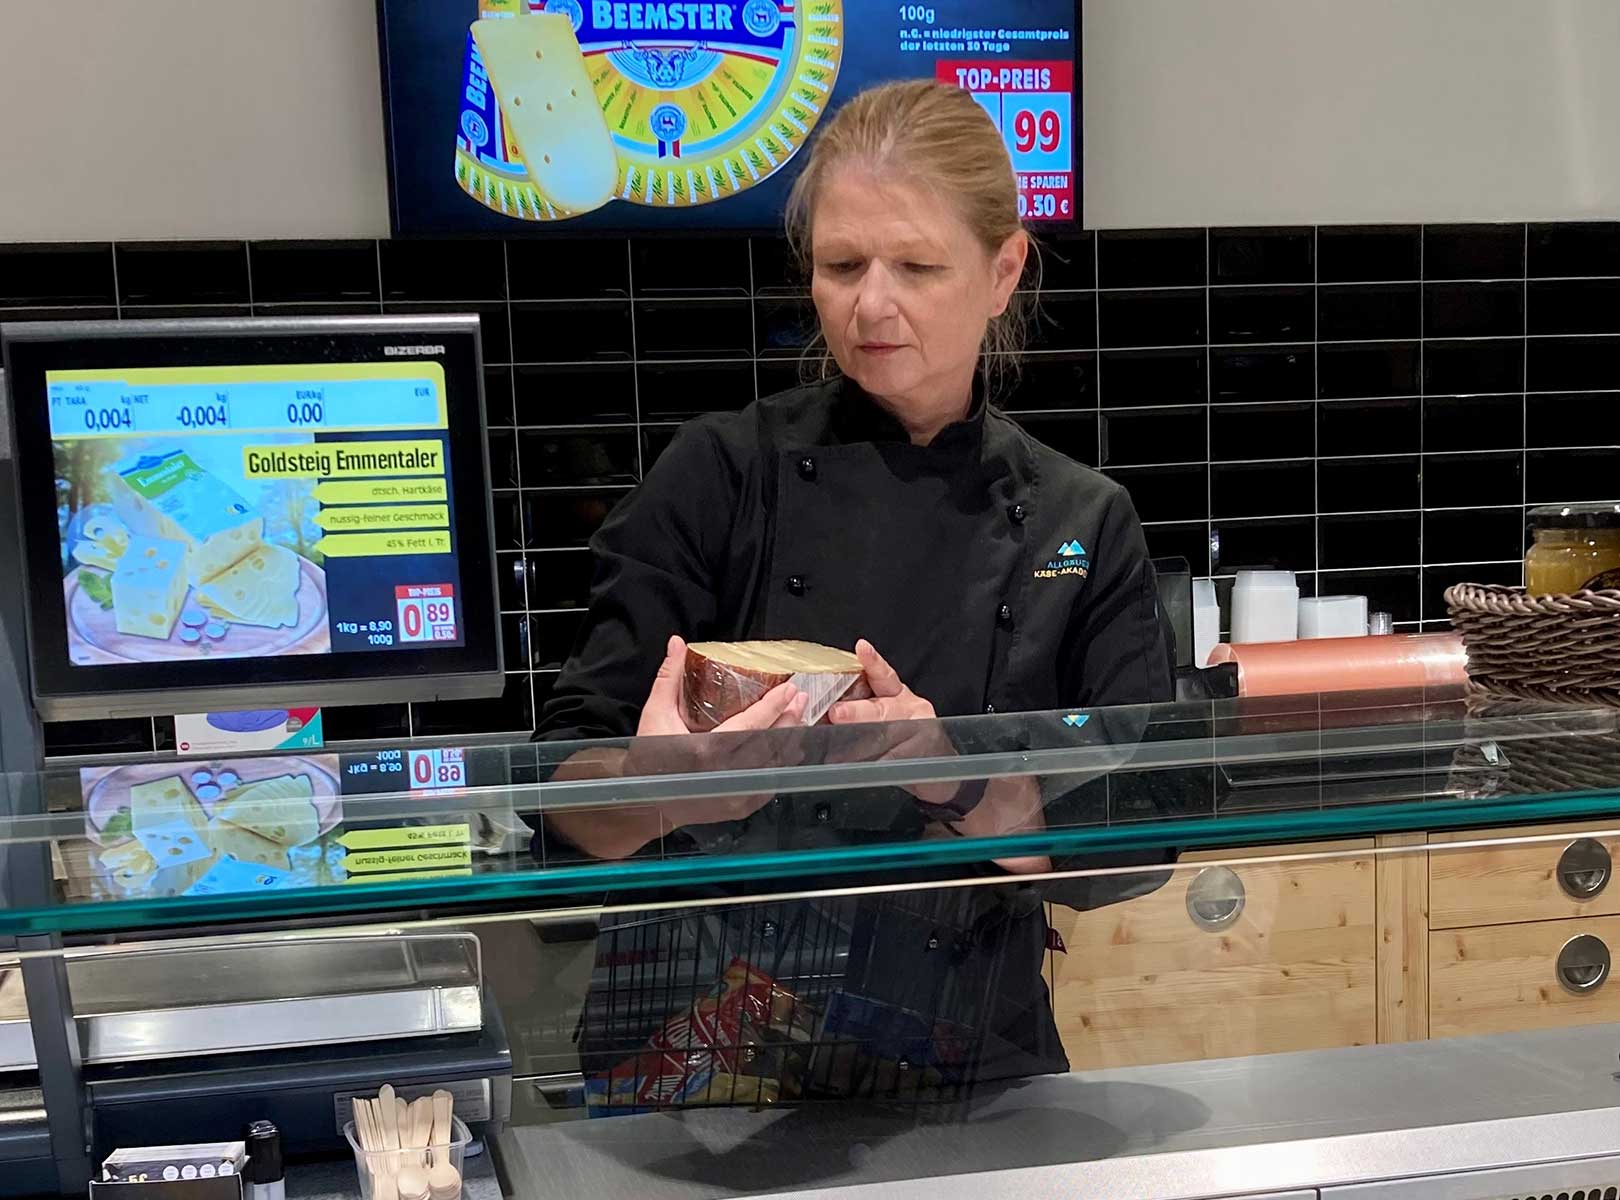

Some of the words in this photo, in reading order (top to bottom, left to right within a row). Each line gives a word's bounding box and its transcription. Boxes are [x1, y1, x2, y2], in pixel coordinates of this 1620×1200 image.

[591, 2, 733, 30] BEEMSTER
[899, 5, 935, 24] 100g
[932, 28, 996, 41] niedrigster
[998, 28, 1069, 41] Gesamtpreis
[900, 41, 920, 51] der
[923, 41, 964, 51] letzten
[982, 41, 1010, 53] Tage
[956, 68, 1051, 90] TOP-PREIS
[1014, 109, 1061, 153] 99
[1030, 175, 1068, 189] SPAREN
[85, 408, 132, 431] 0,004
[176, 406, 226, 428] -0,004
[287, 403, 323, 425] 0,00
[249, 451, 330, 475] Goldsteig
[336, 448, 438, 470] Emmentaler
[393, 512, 444, 522] Geschmack
[403, 603, 422, 637] 0
[426, 602, 450, 622] 89
[336, 622, 358, 633] 1kg
[368, 634, 392, 646] 100g
